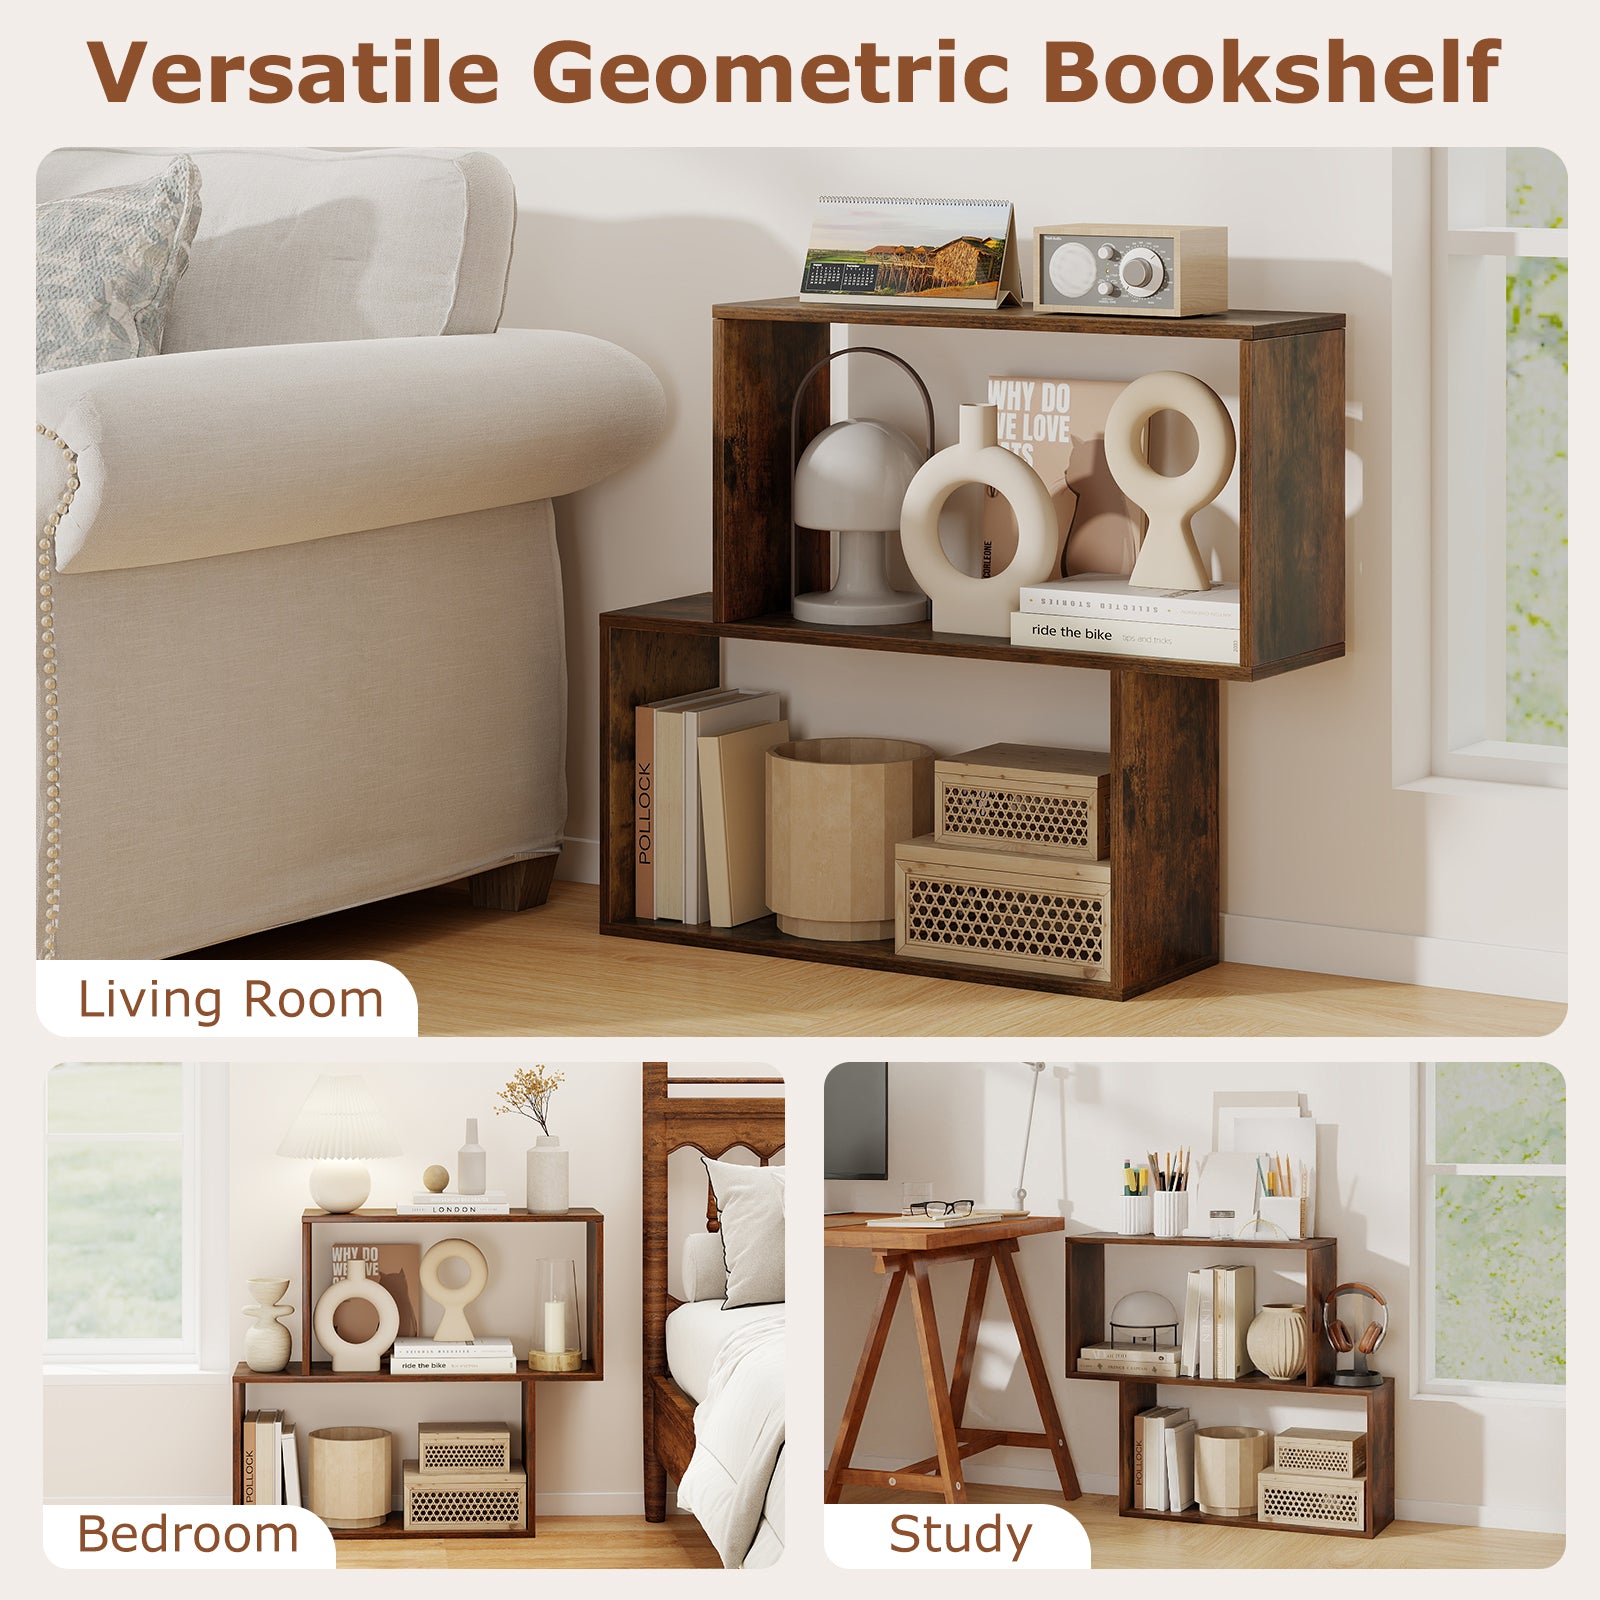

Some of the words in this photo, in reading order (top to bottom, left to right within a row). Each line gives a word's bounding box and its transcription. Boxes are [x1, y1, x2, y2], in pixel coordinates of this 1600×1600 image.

[988, 380, 1035, 411] WHY
[1041, 382, 1071, 414] DO
[1022, 413, 1071, 443] LOVE
[982, 540, 993, 579] CORLEONE
[1040, 598, 1092, 608] STORIES
[1032, 624, 1057, 637] ride
[1060, 626, 1082, 639] the
[1085, 628, 1113, 641] bike
[638, 762, 651, 865] POLLOCK
[332, 1246, 359, 1262] WHY
[362, 1246, 379, 1262] DO
[245, 1450, 254, 1503] POLLOCK
[1135, 1440, 1143, 1486] POLLOCK
